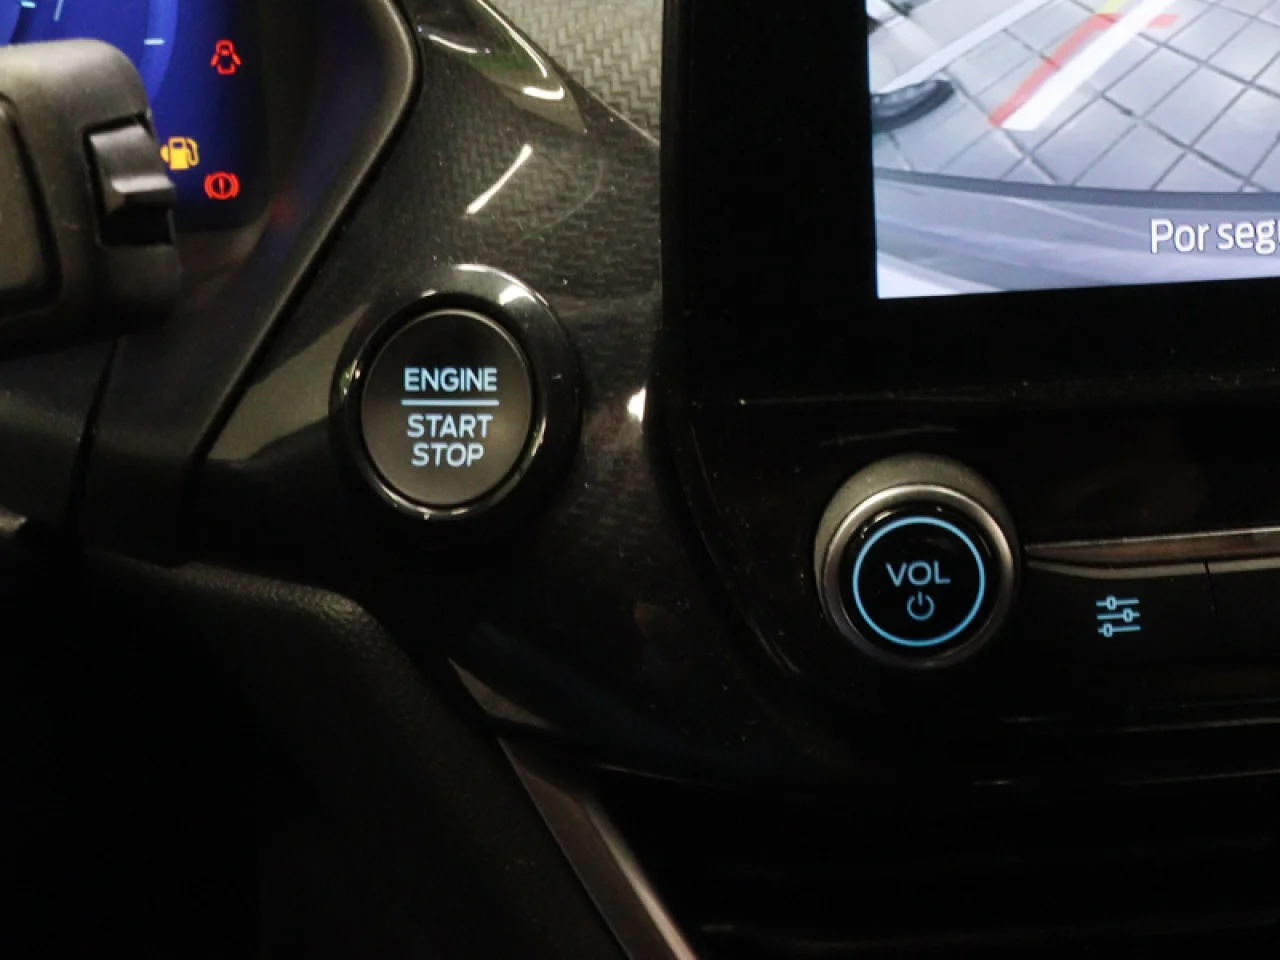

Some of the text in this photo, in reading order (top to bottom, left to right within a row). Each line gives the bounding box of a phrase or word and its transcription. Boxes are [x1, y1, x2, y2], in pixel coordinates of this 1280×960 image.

[1151, 218, 1210, 254] Por
[404, 367, 497, 392] ENGINE
[407, 412, 494, 438] START
[411, 442, 484, 467] STOP
[885, 560, 951, 587] VOL
